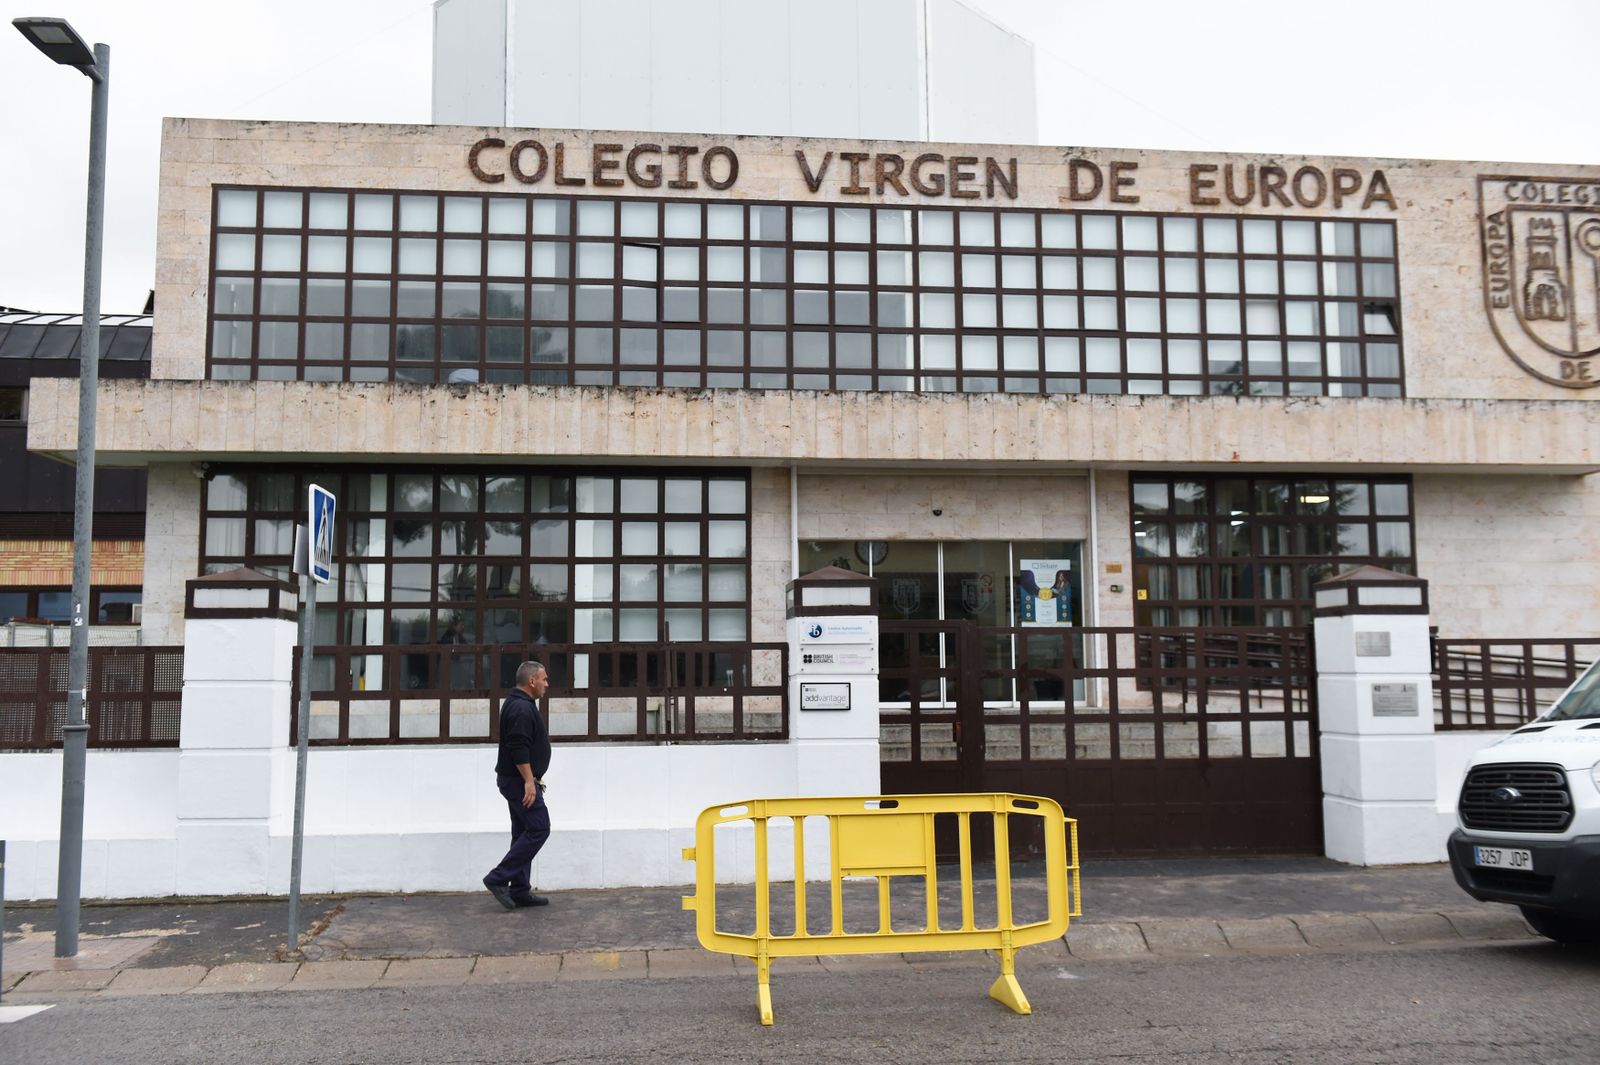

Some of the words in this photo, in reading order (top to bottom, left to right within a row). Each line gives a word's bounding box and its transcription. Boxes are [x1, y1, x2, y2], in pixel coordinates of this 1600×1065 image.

[468, 138, 739, 190] COLEGIO
[794, 149, 1018, 199] VIRGEN
[1069, 158, 1140, 203] DE
[1190, 163, 1398, 211] EUROPA
[1487, 210, 1510, 309] EUROPA
[1560, 360, 1593, 381] DE
[804, 694, 846, 704] addvantage
[1480, 849, 1502, 865] 3257
[1509, 850, 1529, 867] JDP
